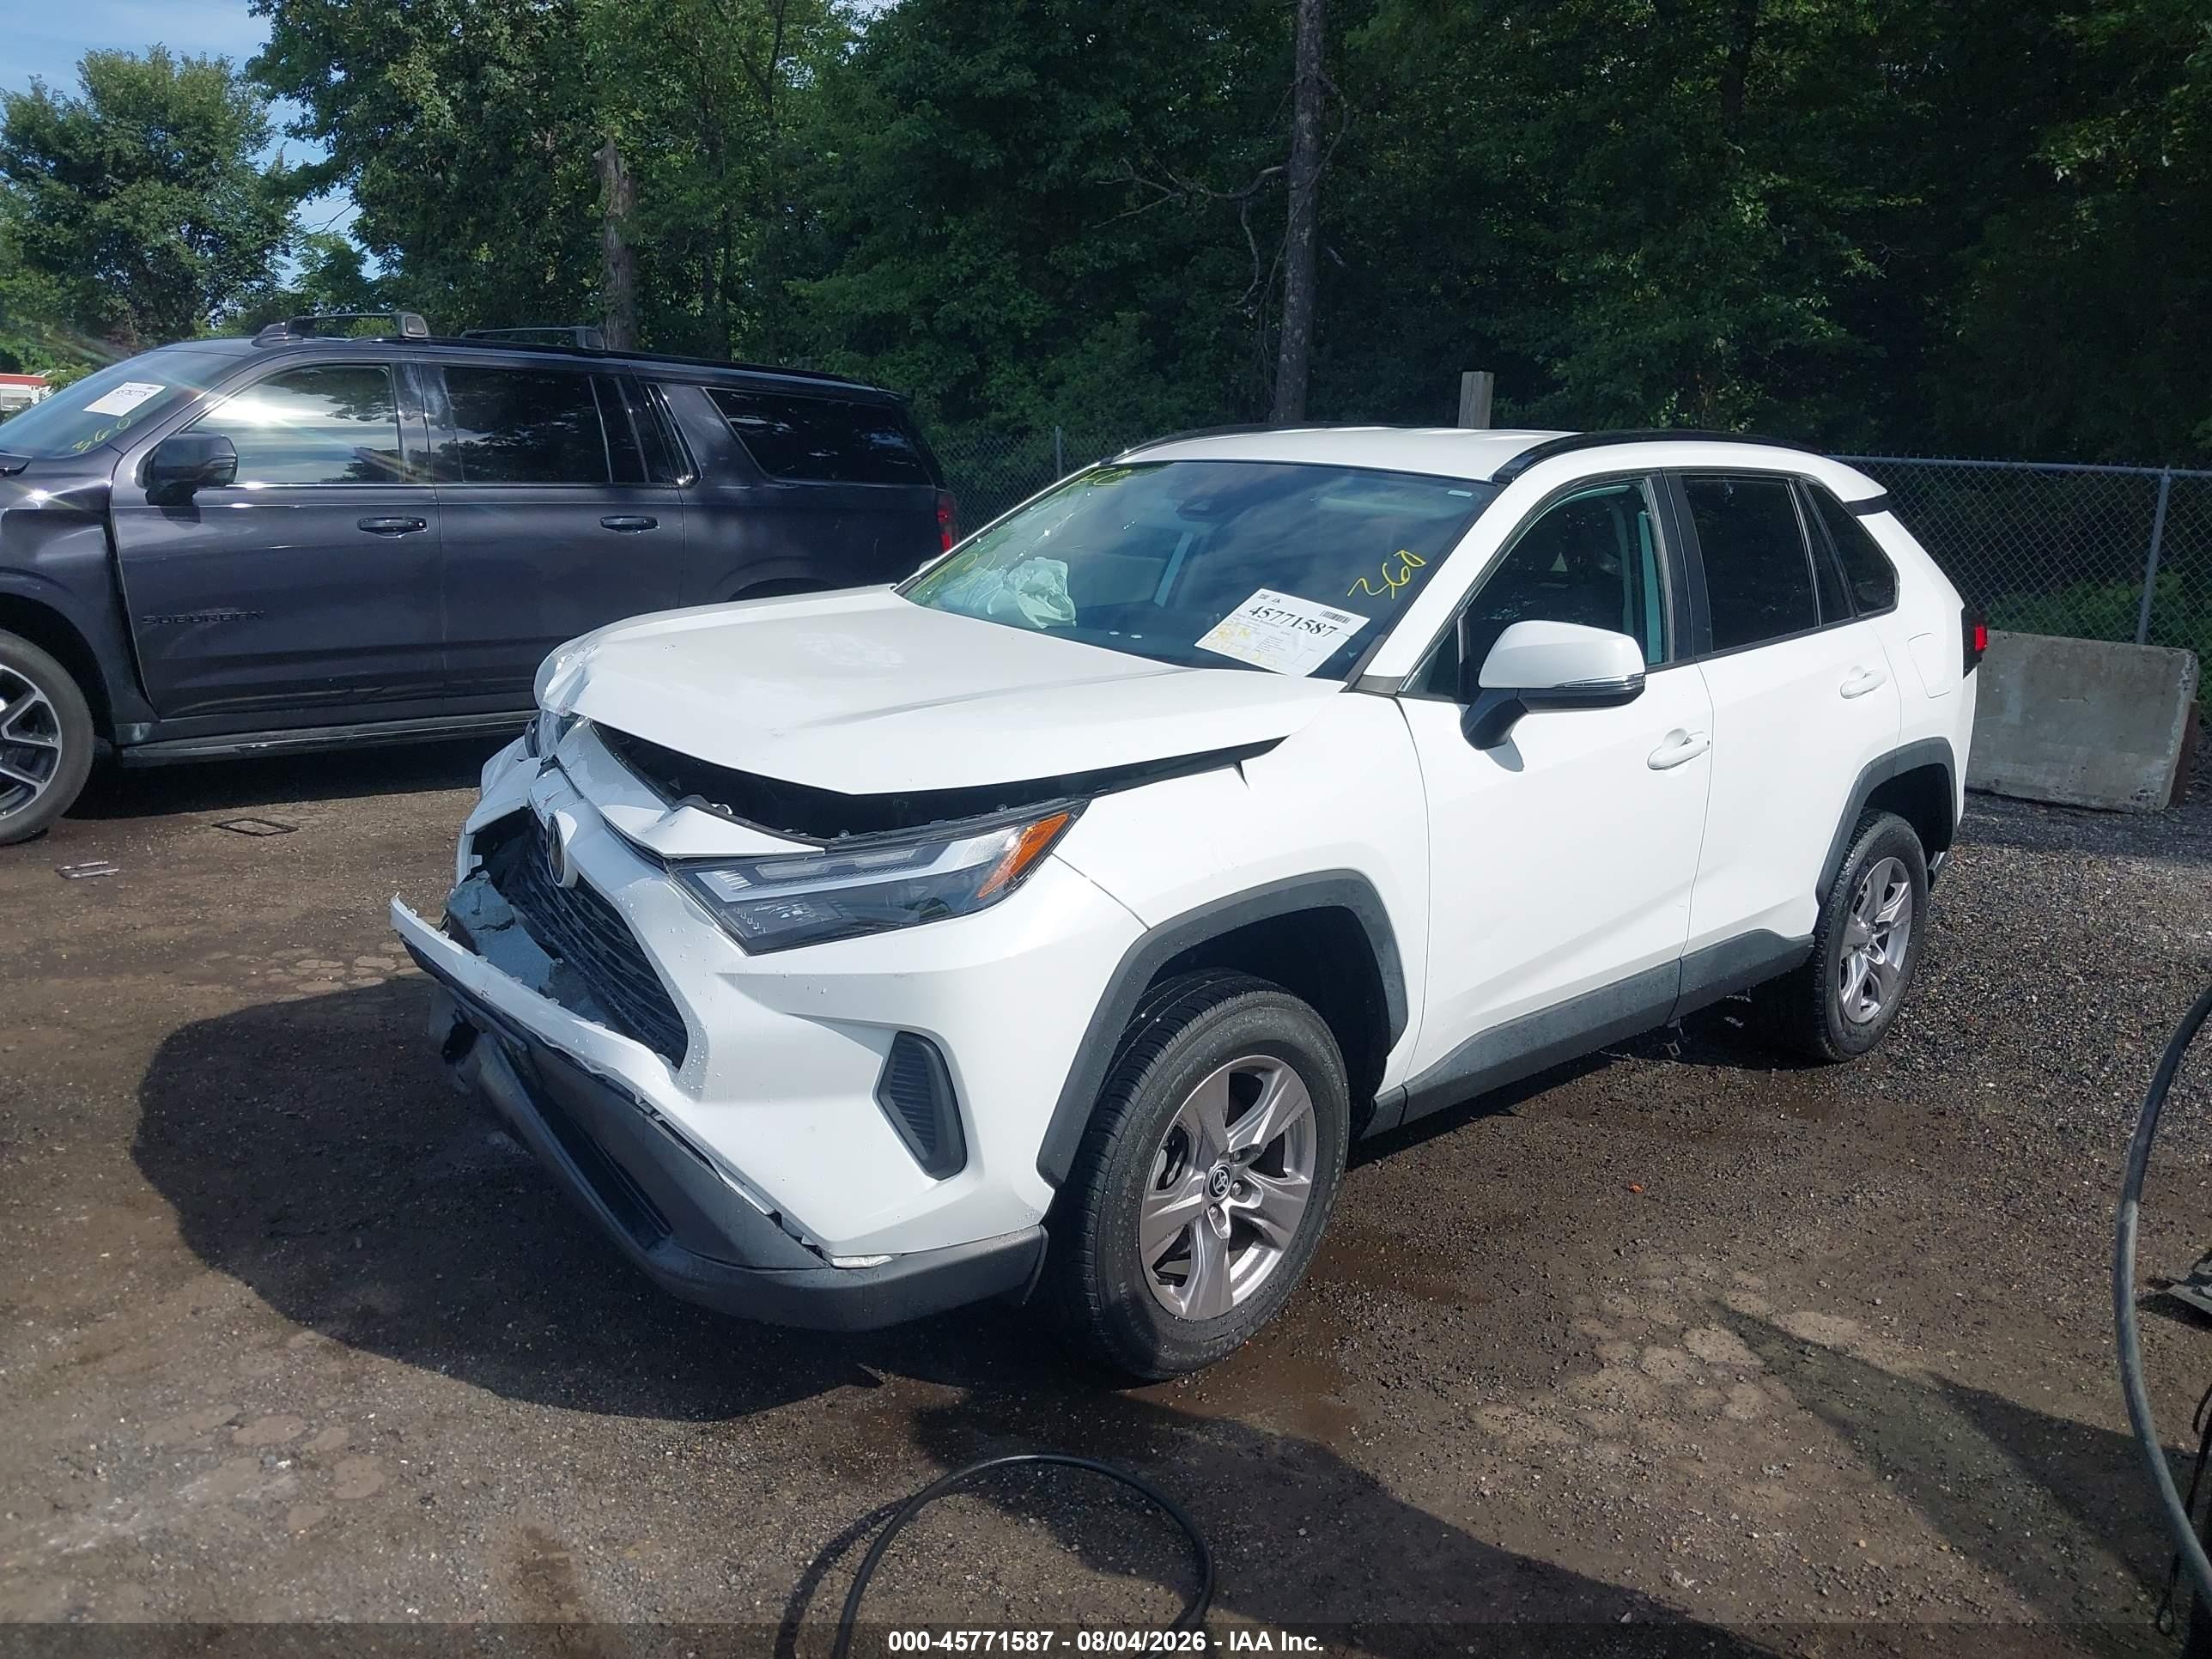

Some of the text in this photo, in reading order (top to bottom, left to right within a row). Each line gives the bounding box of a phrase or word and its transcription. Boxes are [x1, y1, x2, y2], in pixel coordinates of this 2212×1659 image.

[71, 417, 131, 453] 360
[142, 610, 265, 626] SUBURBAN
[1249, 605, 1340, 638] 45771587
